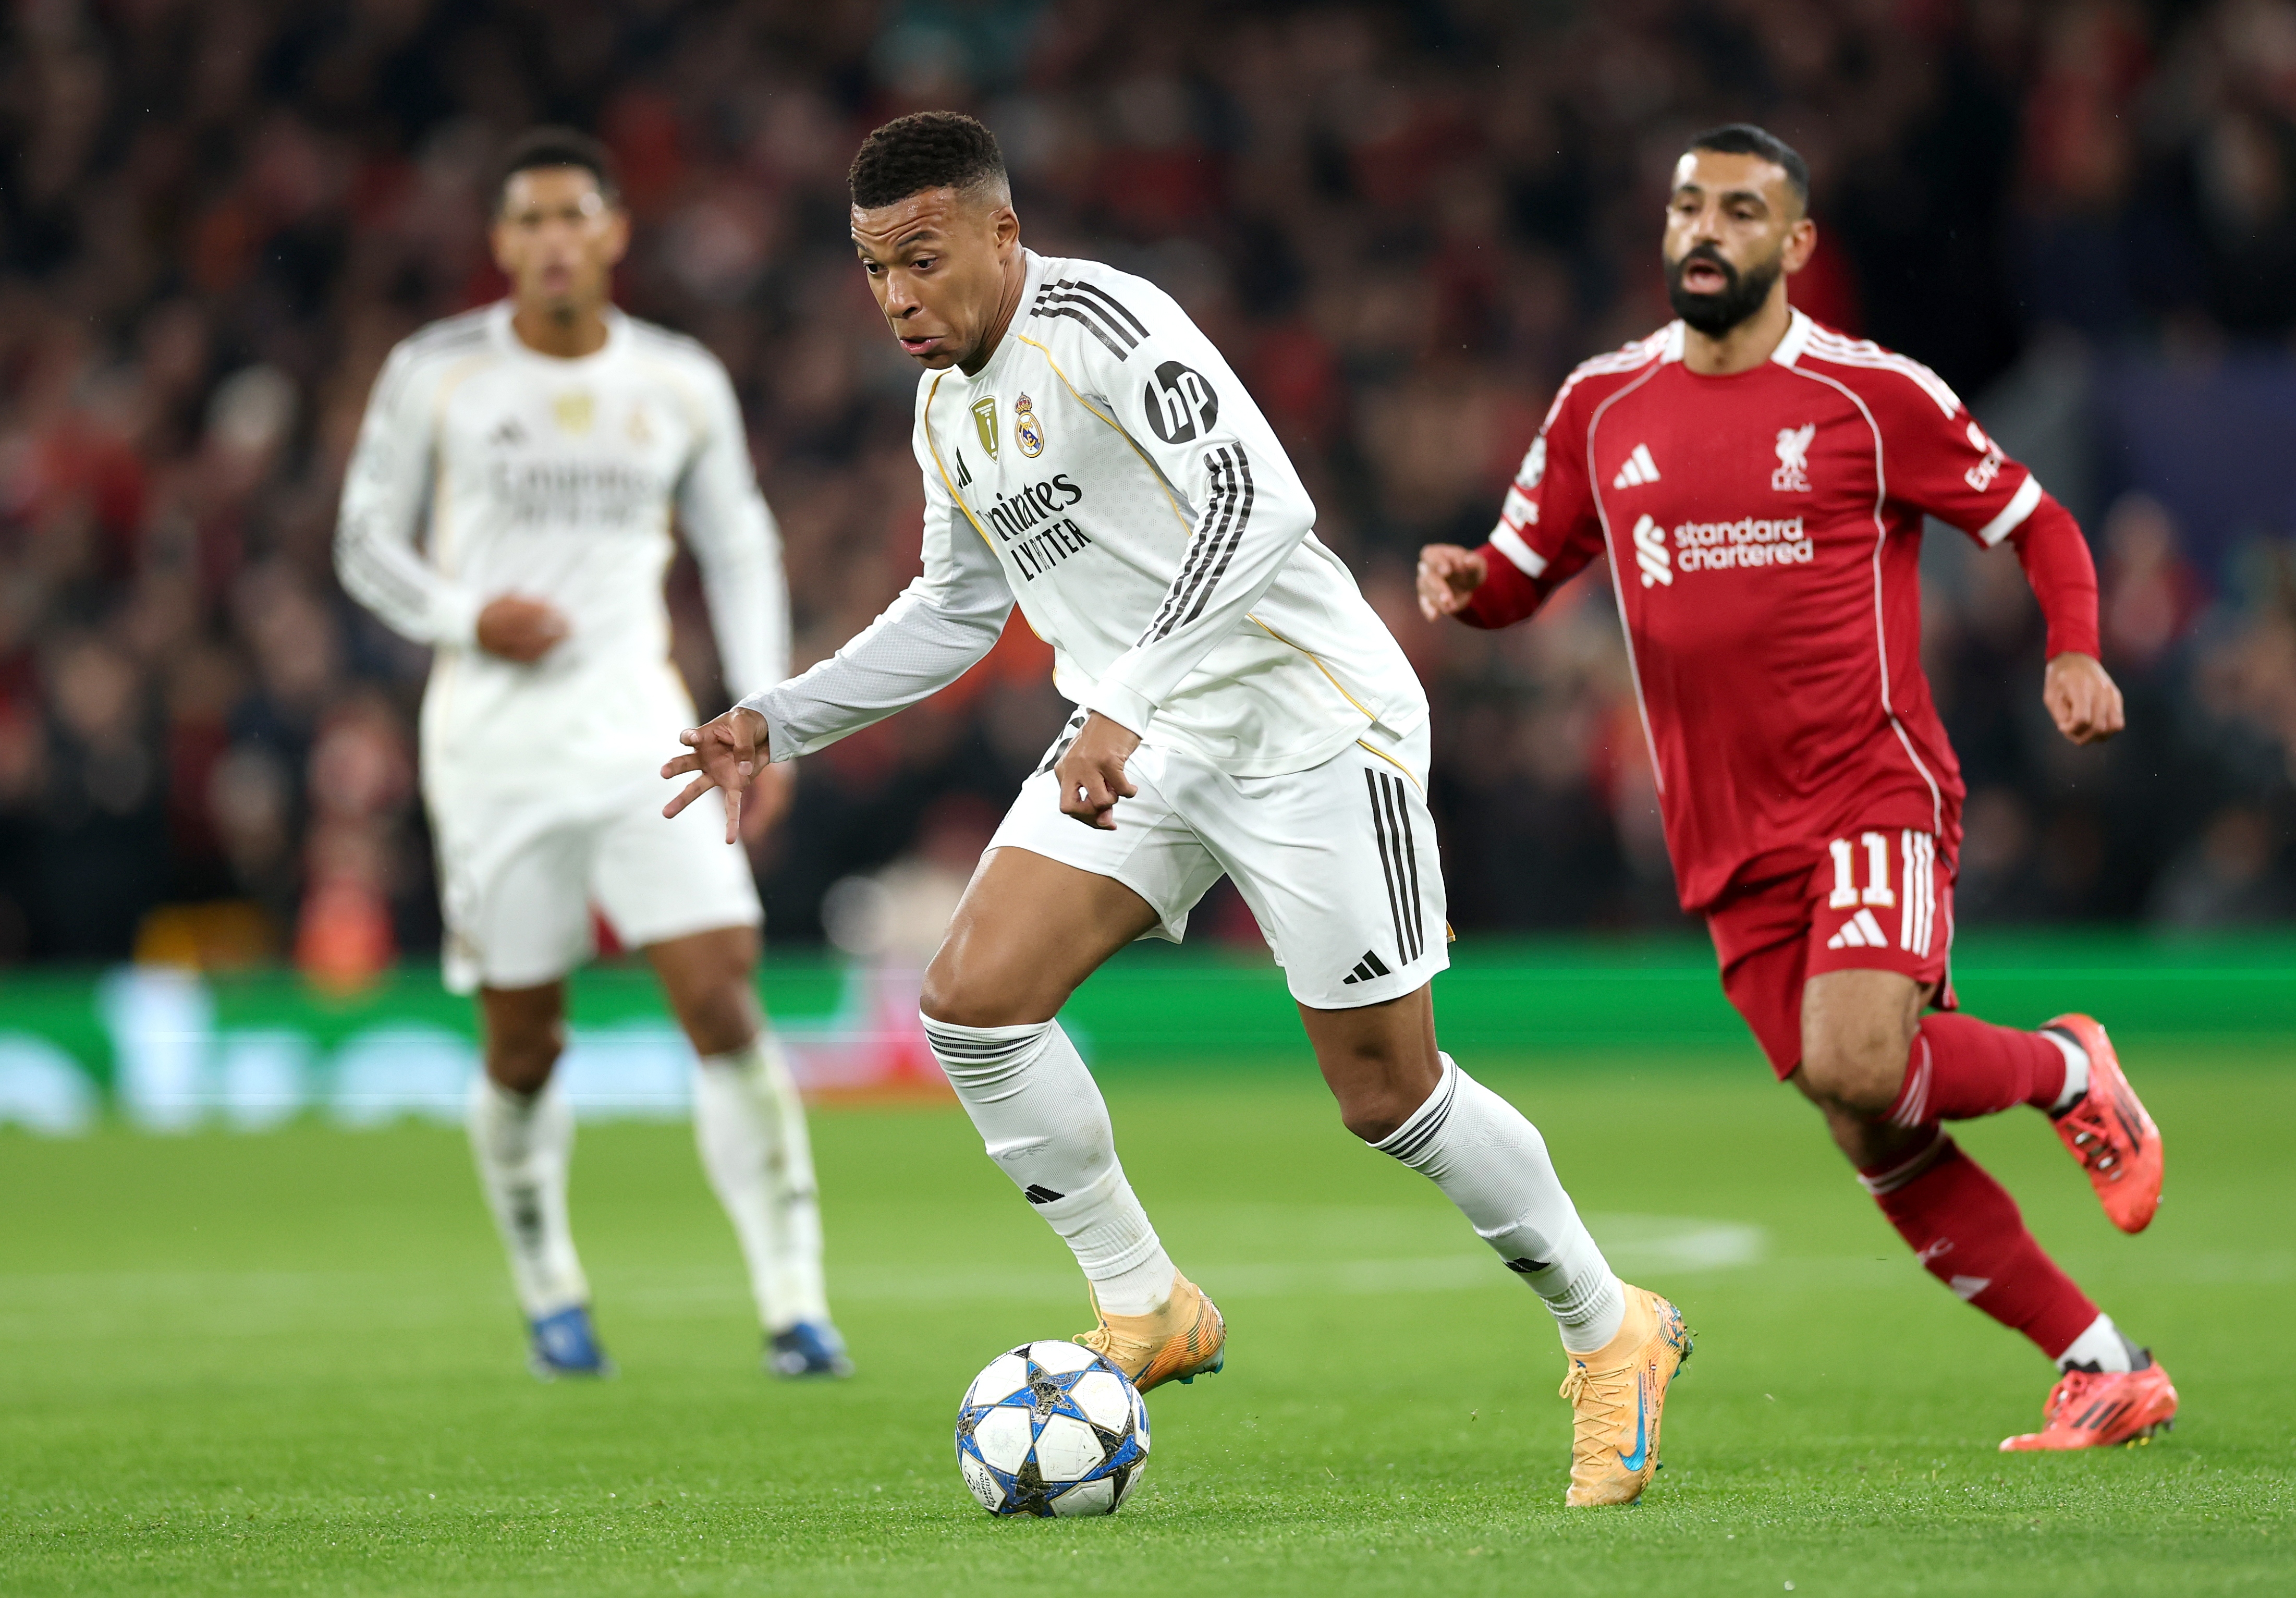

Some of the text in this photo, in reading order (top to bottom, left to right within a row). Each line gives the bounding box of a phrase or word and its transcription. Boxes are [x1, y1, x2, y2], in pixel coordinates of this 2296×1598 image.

[1145, 361, 1218, 444] hp
[975, 473, 1082, 542] mirates
[1674, 516, 1804, 548] standard
[1010, 518, 1092, 581] LY TTER
[1678, 536, 1814, 572] chartered
[1829, 832, 1896, 909] 11
